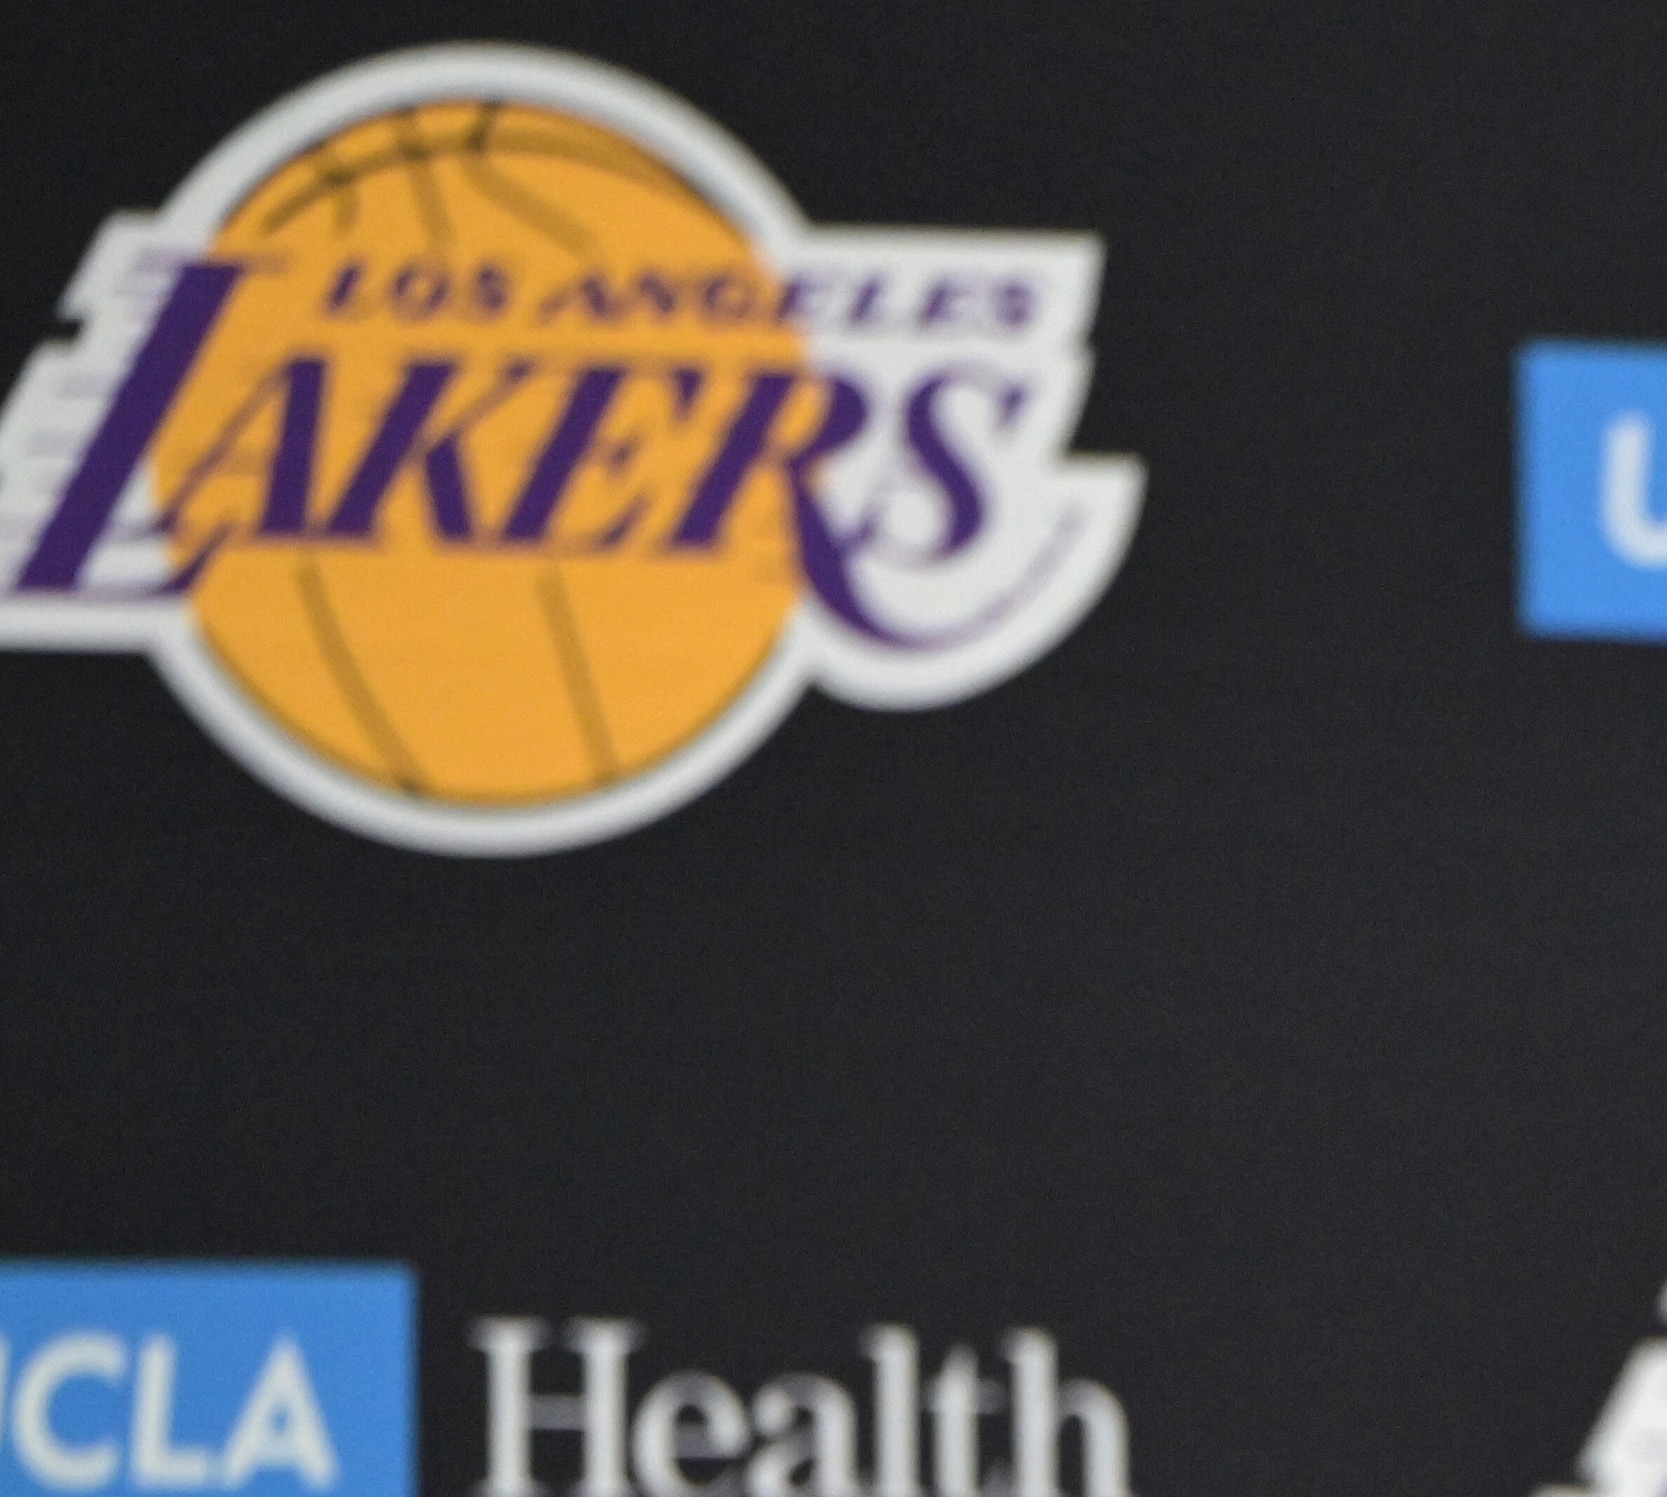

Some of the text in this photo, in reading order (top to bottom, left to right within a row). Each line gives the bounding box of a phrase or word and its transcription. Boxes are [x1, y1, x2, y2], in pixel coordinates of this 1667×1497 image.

[322, 256, 1040, 330] LOS ANGELES
[5, 256, 1085, 650] LAKERS
[0, 1326, 340, 1494] CLA
